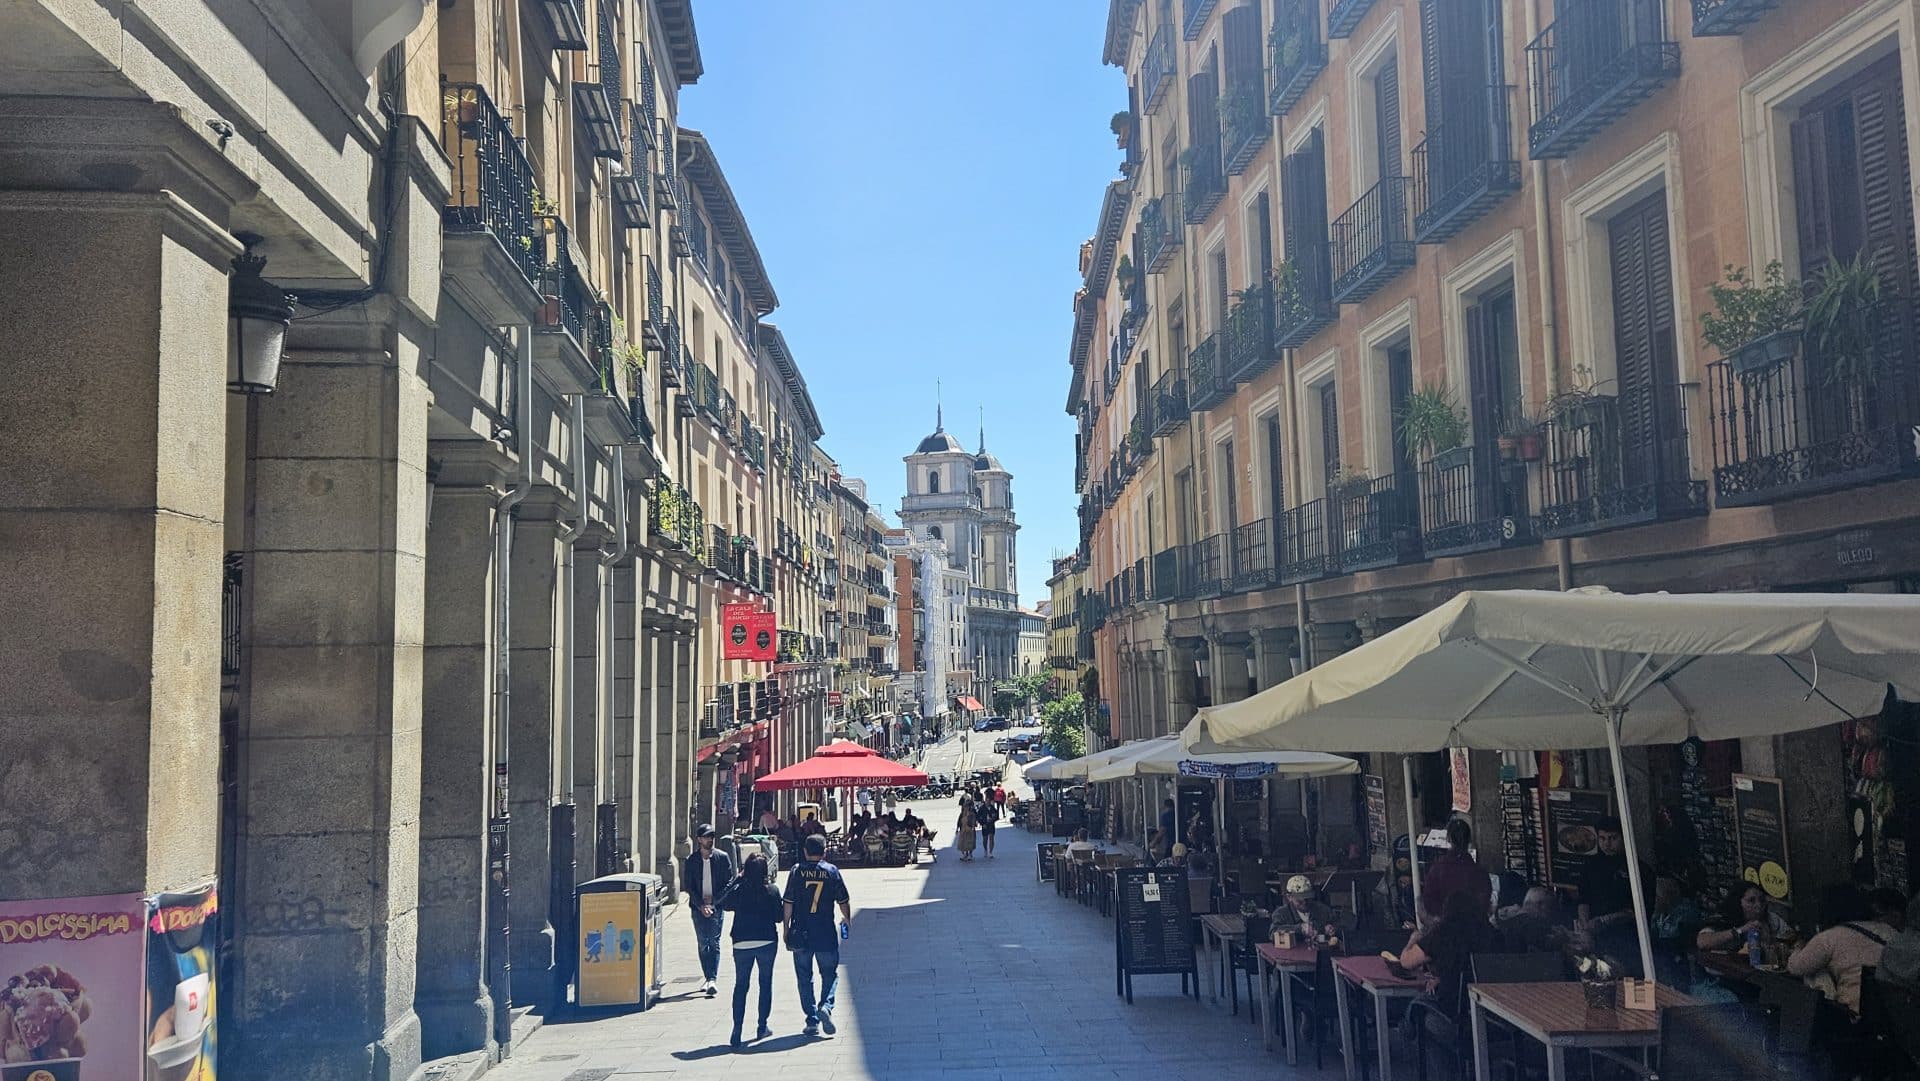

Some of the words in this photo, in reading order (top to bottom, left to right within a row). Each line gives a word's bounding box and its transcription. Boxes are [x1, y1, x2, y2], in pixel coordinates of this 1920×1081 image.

[806, 778, 833, 787] CASA
[835, 777, 852, 785] DEL
[854, 776, 892, 785] ABUELO
[800, 870, 817, 879] VINI
[805, 880, 824, 913] 7
[0, 914, 129, 943] DOLCISSIMA
